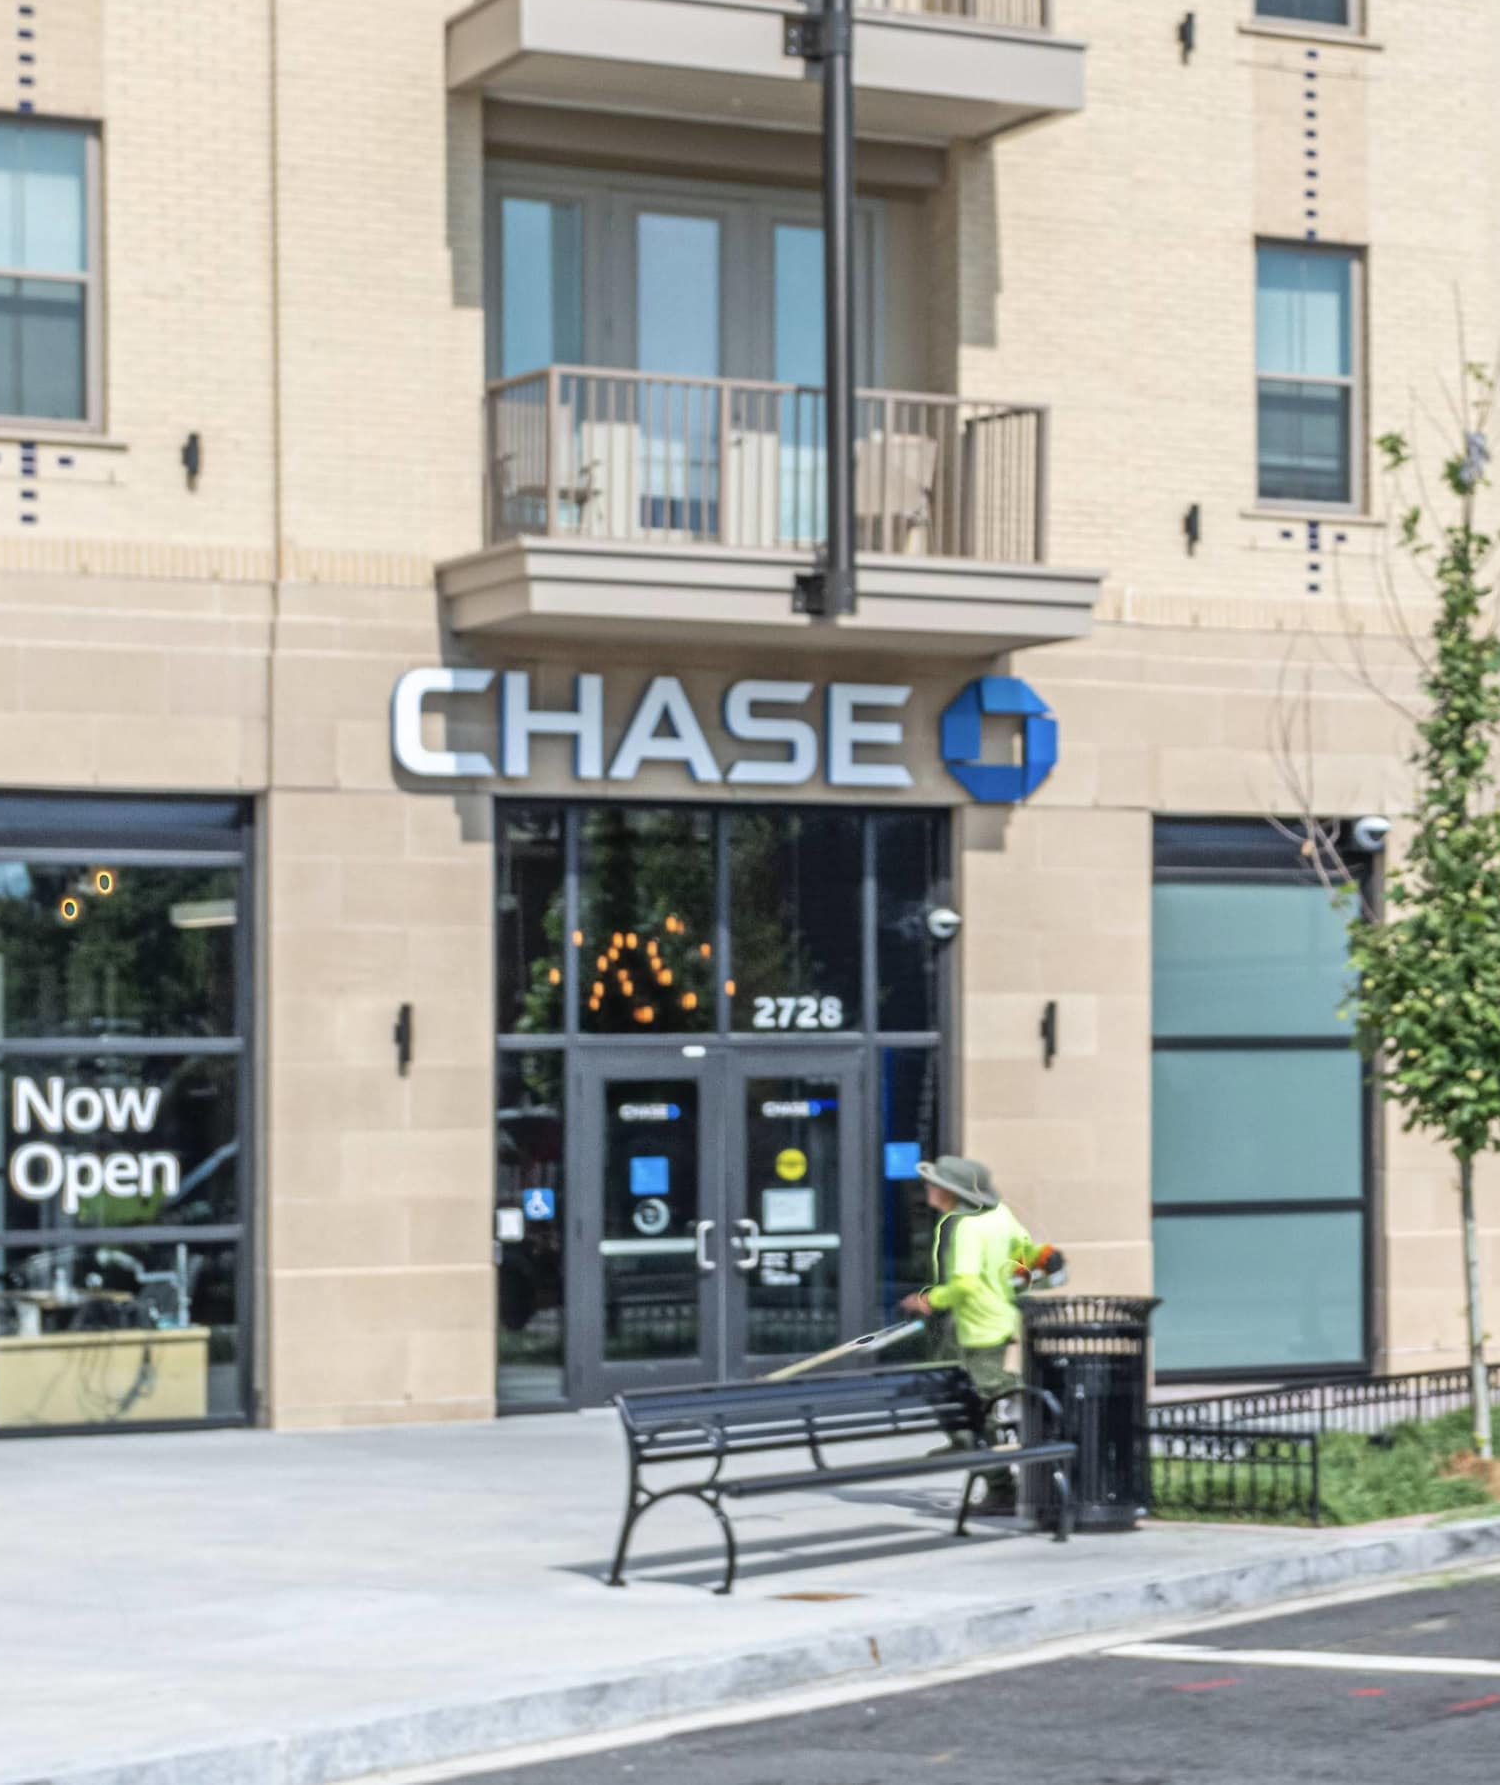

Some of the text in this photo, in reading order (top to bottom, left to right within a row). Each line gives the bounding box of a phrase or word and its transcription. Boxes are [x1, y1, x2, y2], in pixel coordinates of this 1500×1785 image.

[392, 668, 914, 786] CHASE
[752, 995, 844, 1029] 2728
[13, 1076, 162, 1133] Now
[9, 1141, 180, 1214] Open
